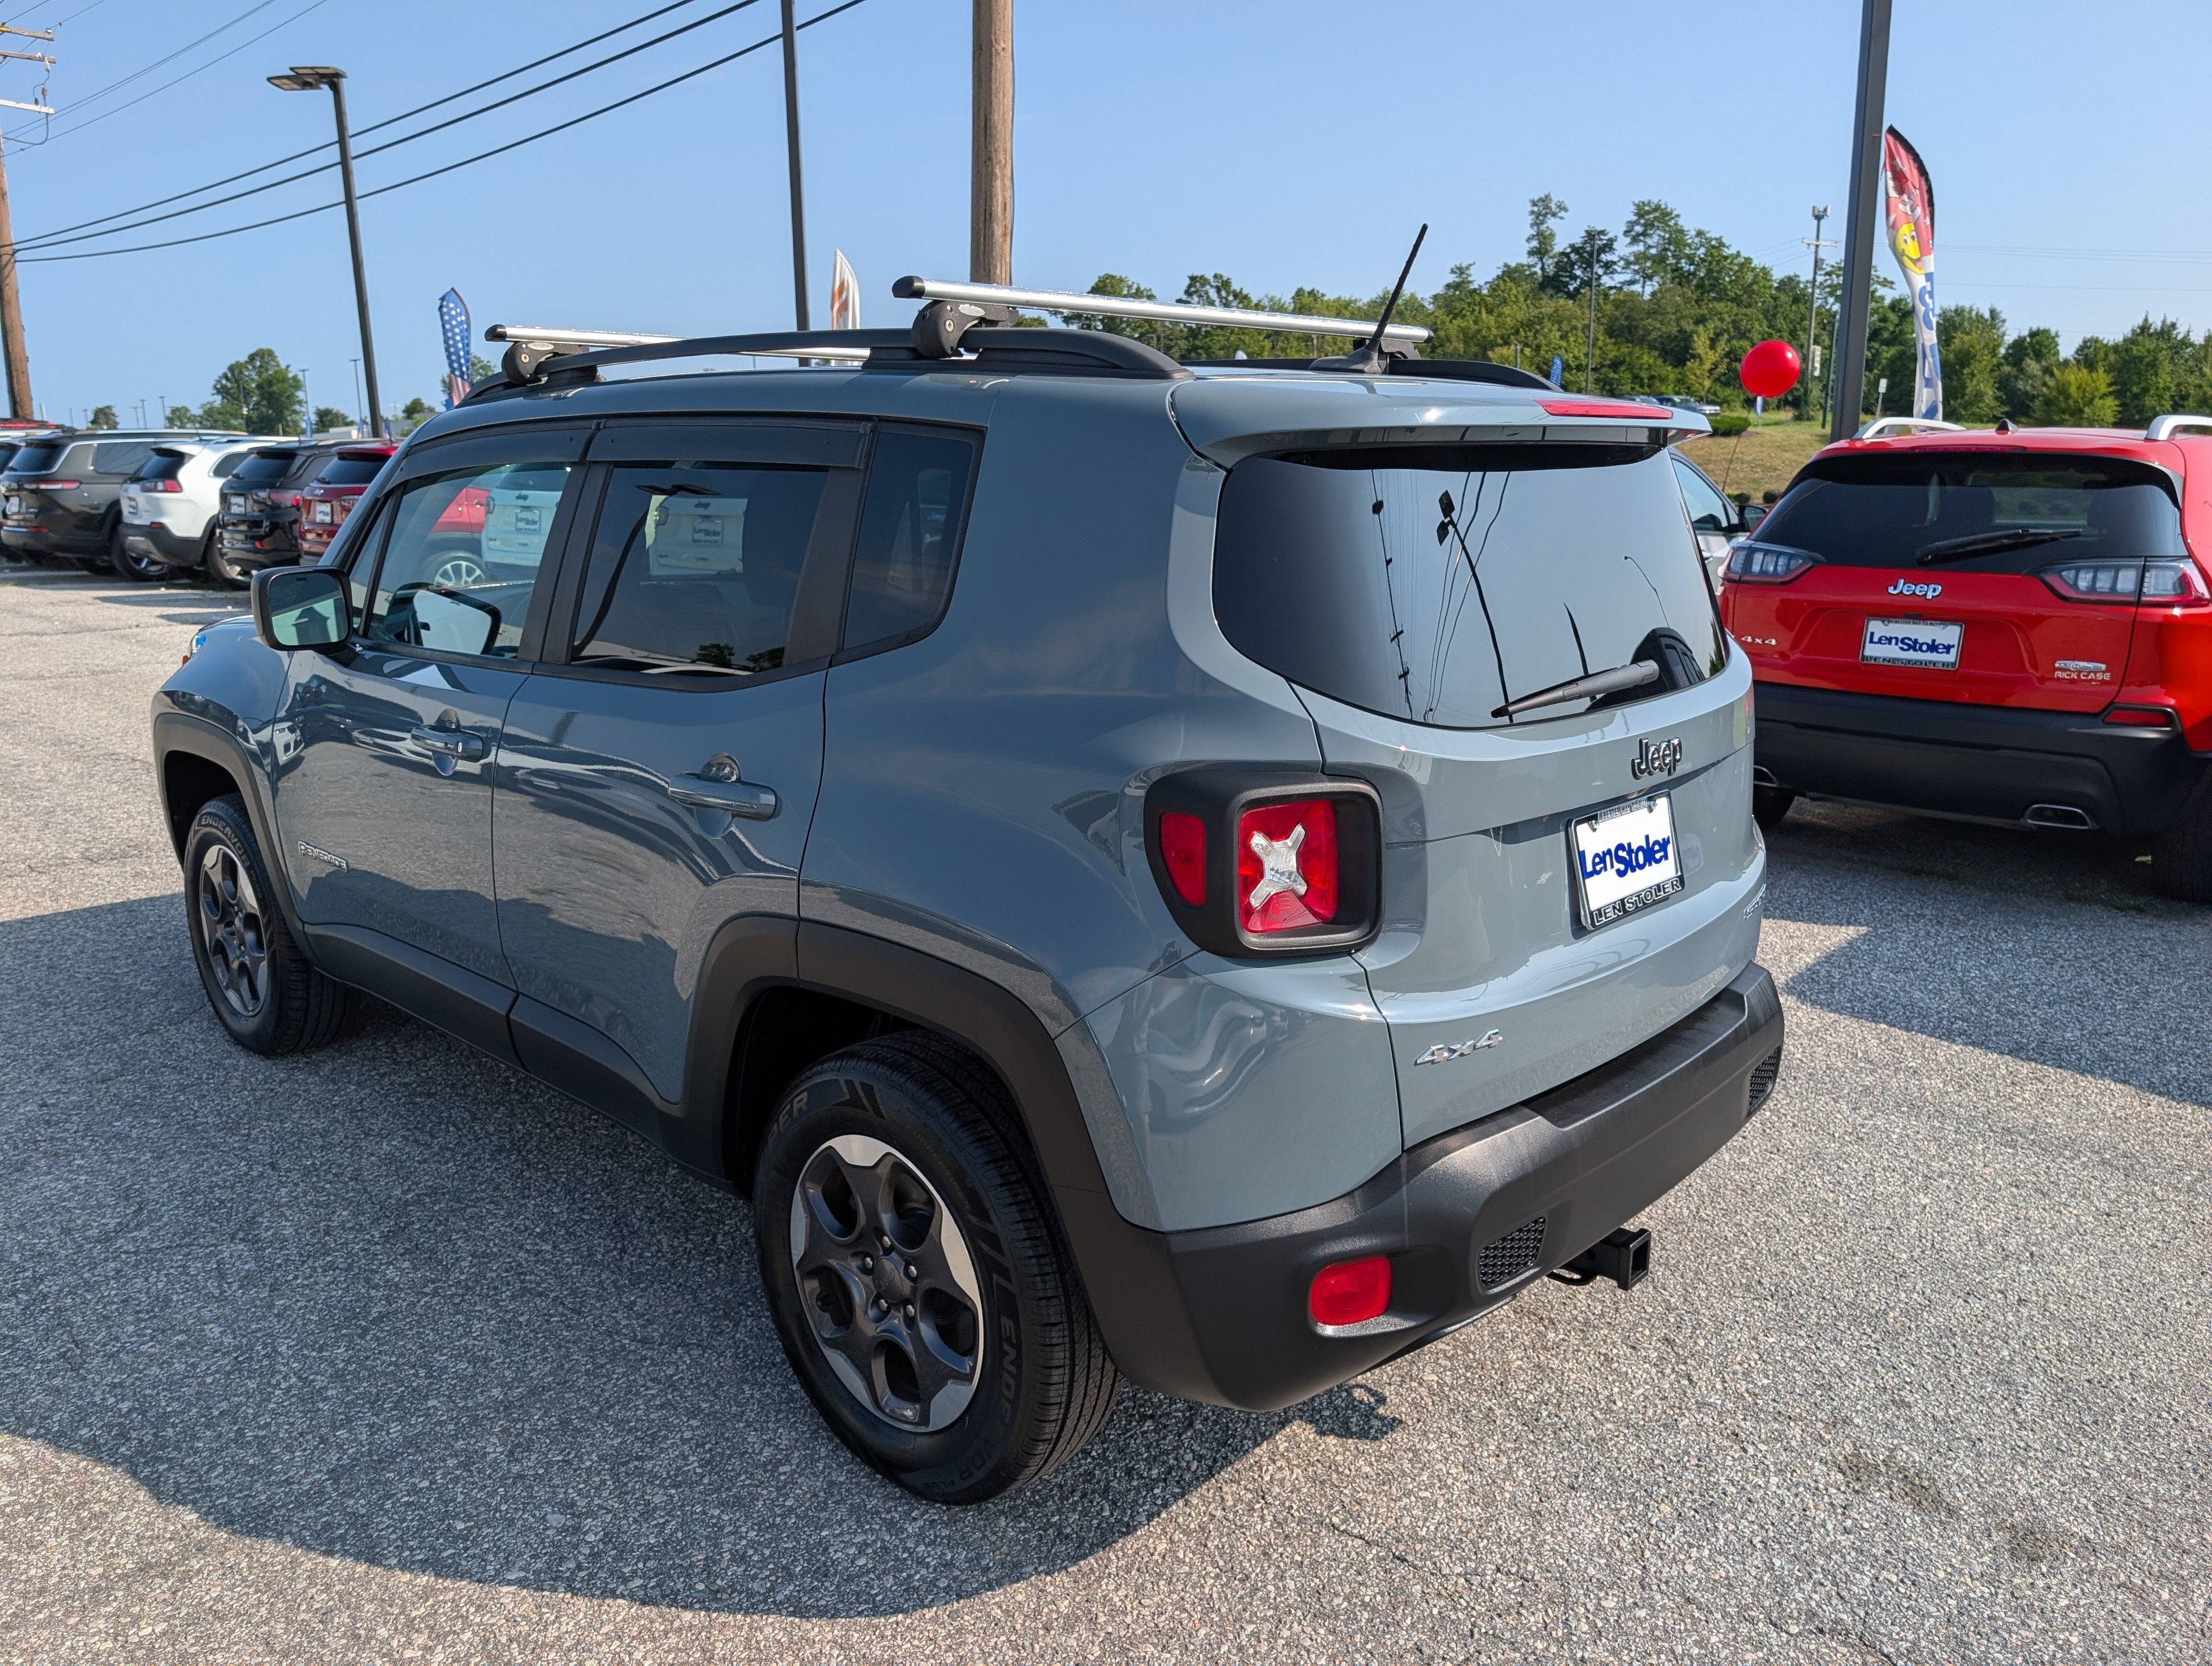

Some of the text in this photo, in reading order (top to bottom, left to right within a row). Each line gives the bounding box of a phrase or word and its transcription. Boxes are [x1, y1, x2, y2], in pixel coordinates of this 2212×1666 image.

[1887, 578, 1943, 600] Jeep
[1741, 635, 1777, 645] 4x4
[2054, 671, 2111, 680] RICK CASE
[1630, 736, 1682, 780] Jeep
[1621, 803, 1631, 815] WAY
[1593, 877, 1682, 926] LEN STOLER
[1413, 1028, 1503, 1067] 4x4
